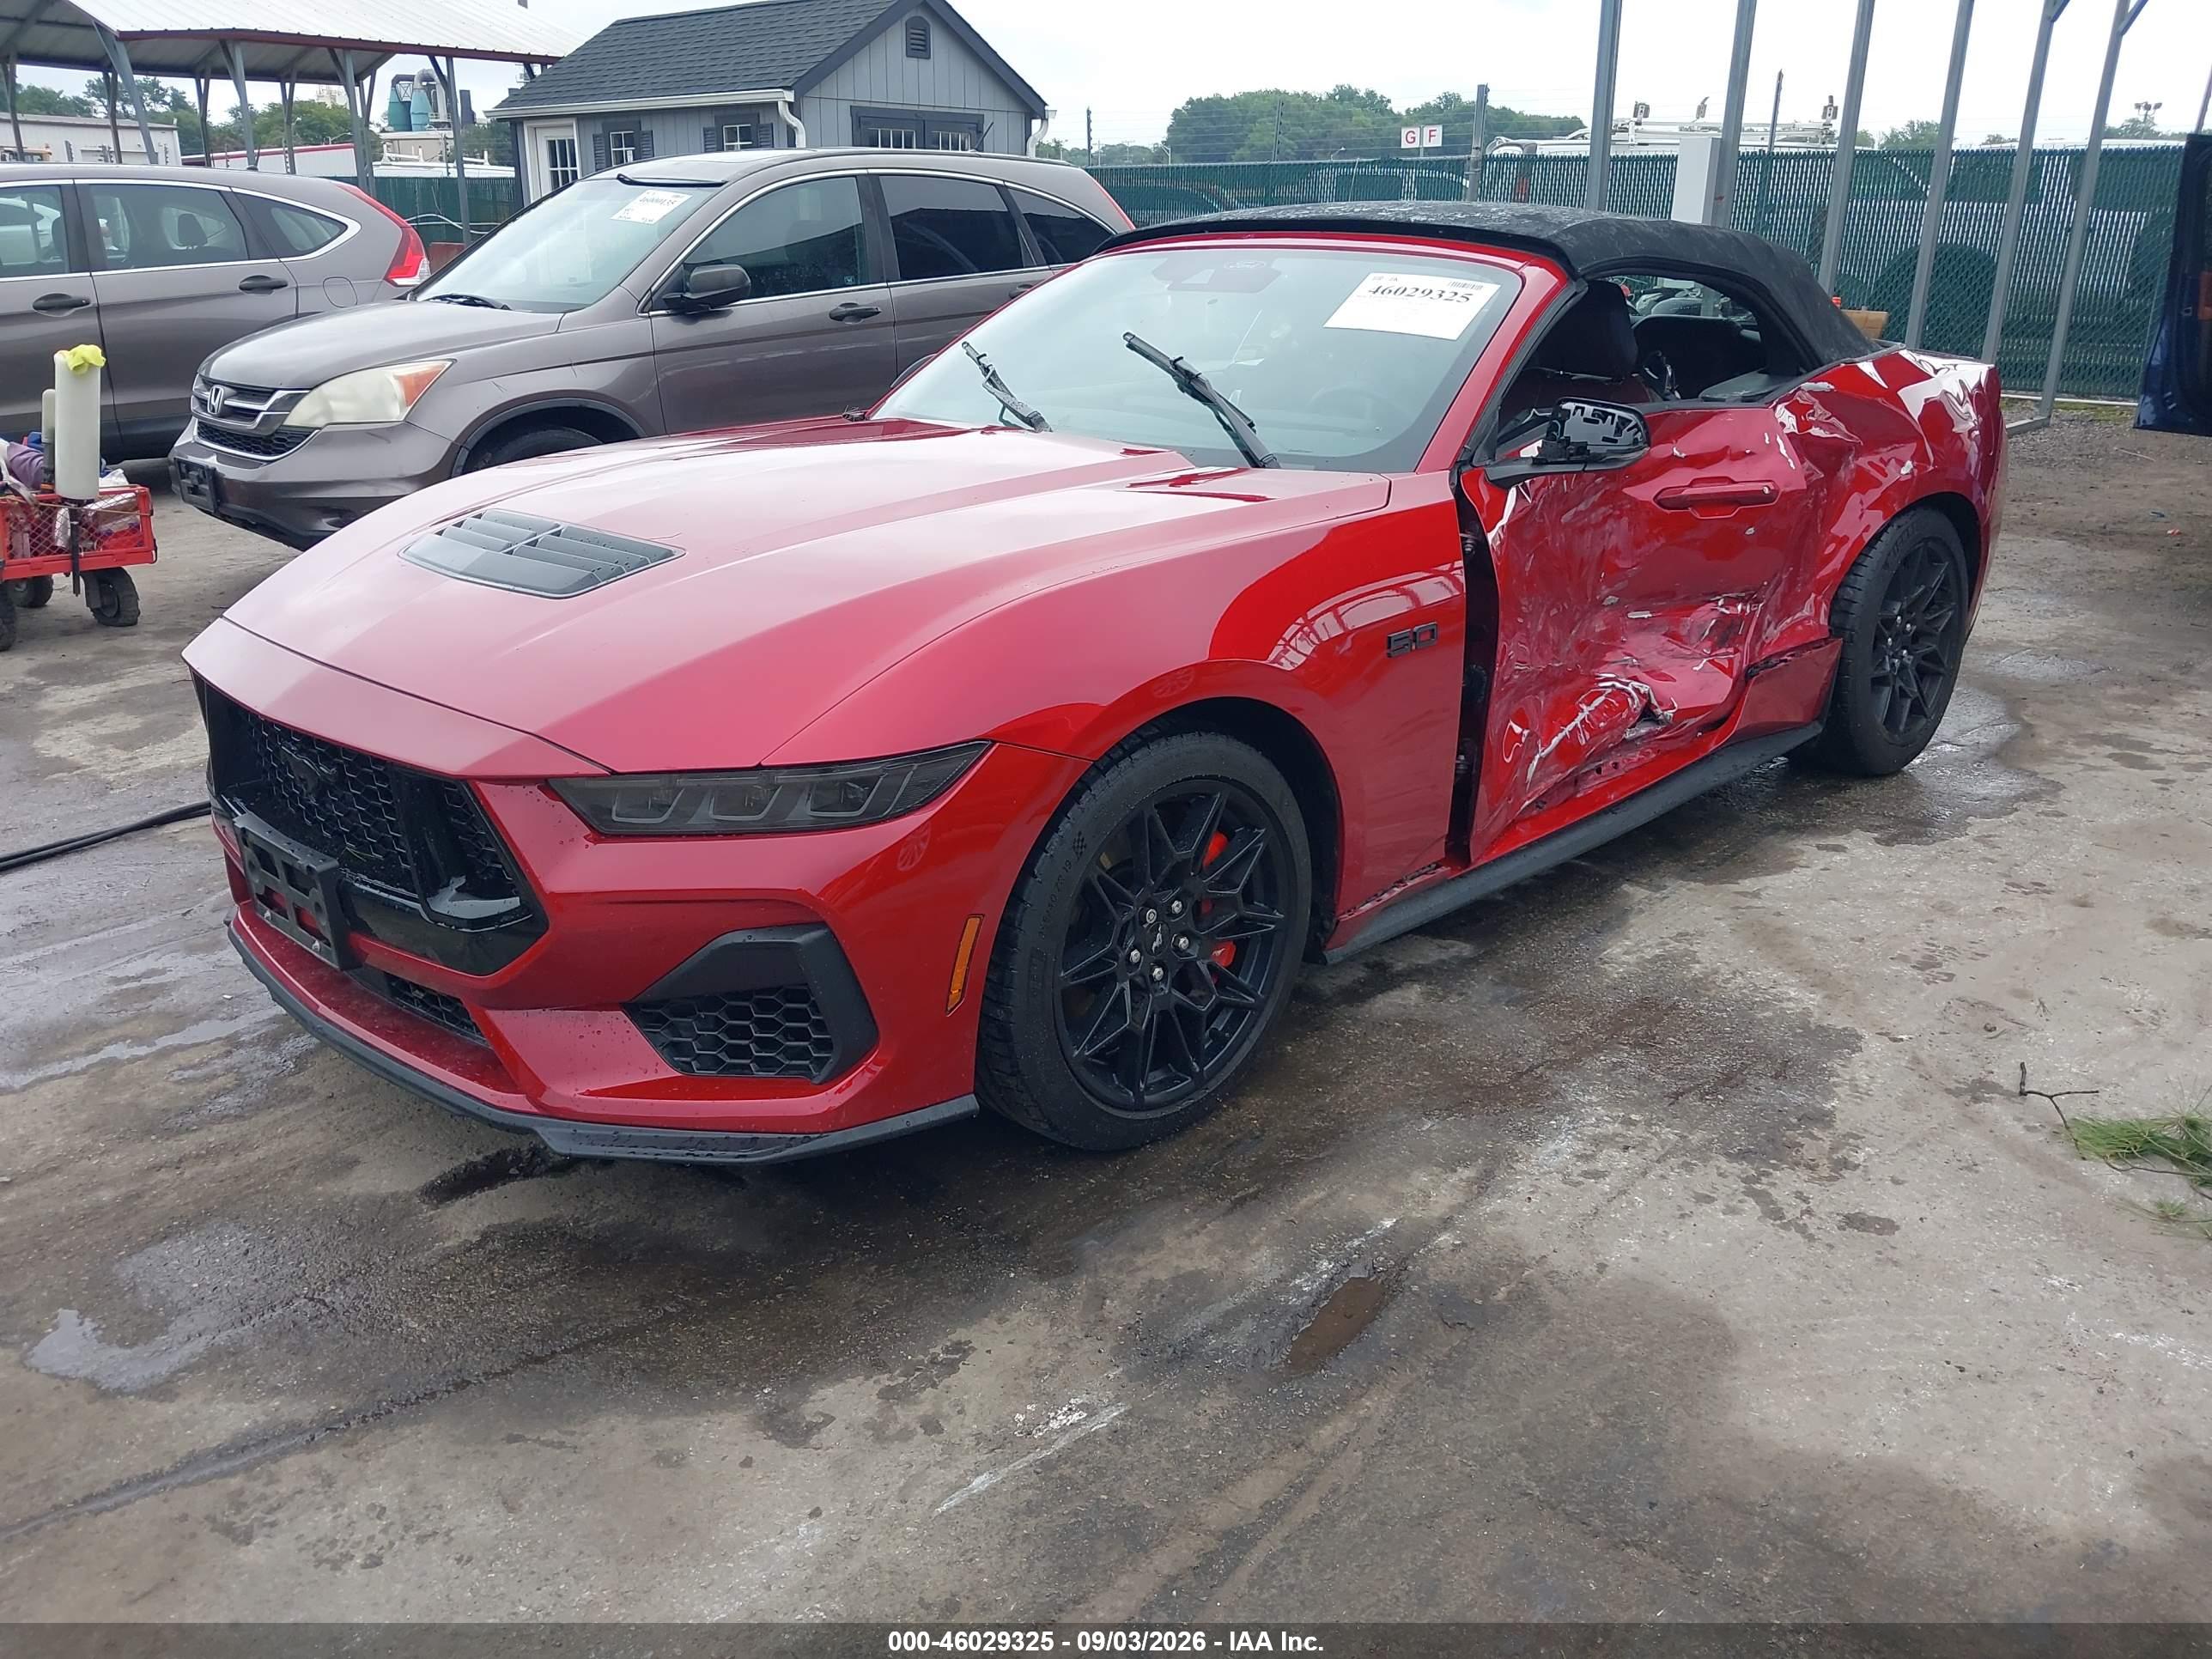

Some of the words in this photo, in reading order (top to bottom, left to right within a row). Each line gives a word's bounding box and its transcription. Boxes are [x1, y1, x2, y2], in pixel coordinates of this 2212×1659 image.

[1405, 130, 1416, 144] G
[1428, 129, 1437, 143] F
[1368, 285, 1474, 303] 46029325
[1387, 622, 1438, 659] 5.0
[1062, 859, 1073, 873] 19
